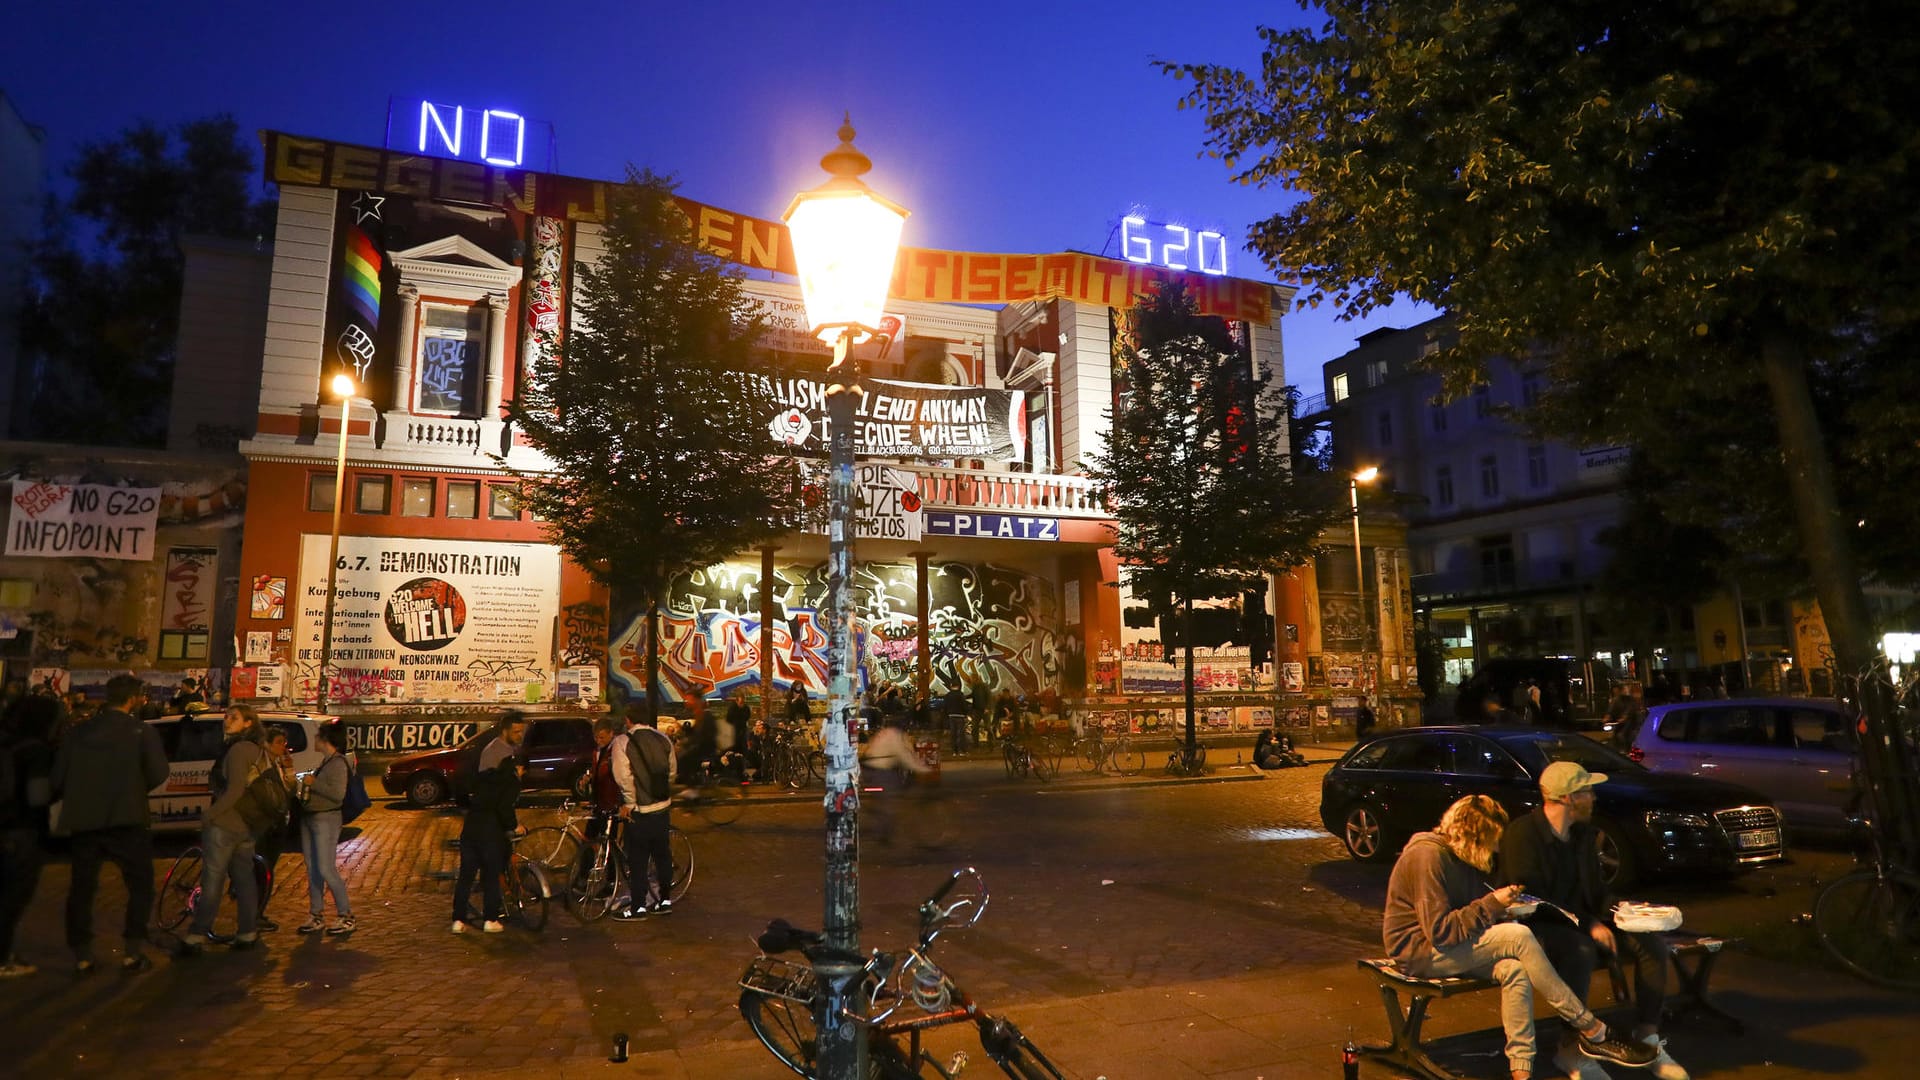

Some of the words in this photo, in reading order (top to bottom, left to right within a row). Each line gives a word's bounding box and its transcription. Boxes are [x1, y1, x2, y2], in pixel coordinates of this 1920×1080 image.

[419, 100, 525, 166] NO
[274, 134, 537, 215] GEGEN
[1122, 215, 1228, 276] G20
[872, 395, 917, 423] END
[919, 396, 988, 424] ANYWAY
[919, 423, 992, 446] WHEN!
[862, 465, 890, 485] DIE
[70, 487, 99, 515] NO
[107, 490, 156, 516] G20
[14, 519, 145, 555] INFOPOINT
[882, 518, 906, 538] LOS
[380, 551, 521, 577] DEMONSTRATION
[391, 598, 435, 615] WELCOME
[393, 613, 404, 625] TO
[403, 607, 461, 643] HELL
[298, 649, 311, 660] DIE
[355, 649, 396, 660] ZITRONEN
[399, 654, 460, 666] NEONSCHWARZ
[371, 668, 405, 681] MAUSER
[413, 670, 450, 682] CAPTAIN
[451, 671, 470, 682] GIPS
[346, 725, 396, 750] BLACK
[401, 724, 470, 748] BLOCK
